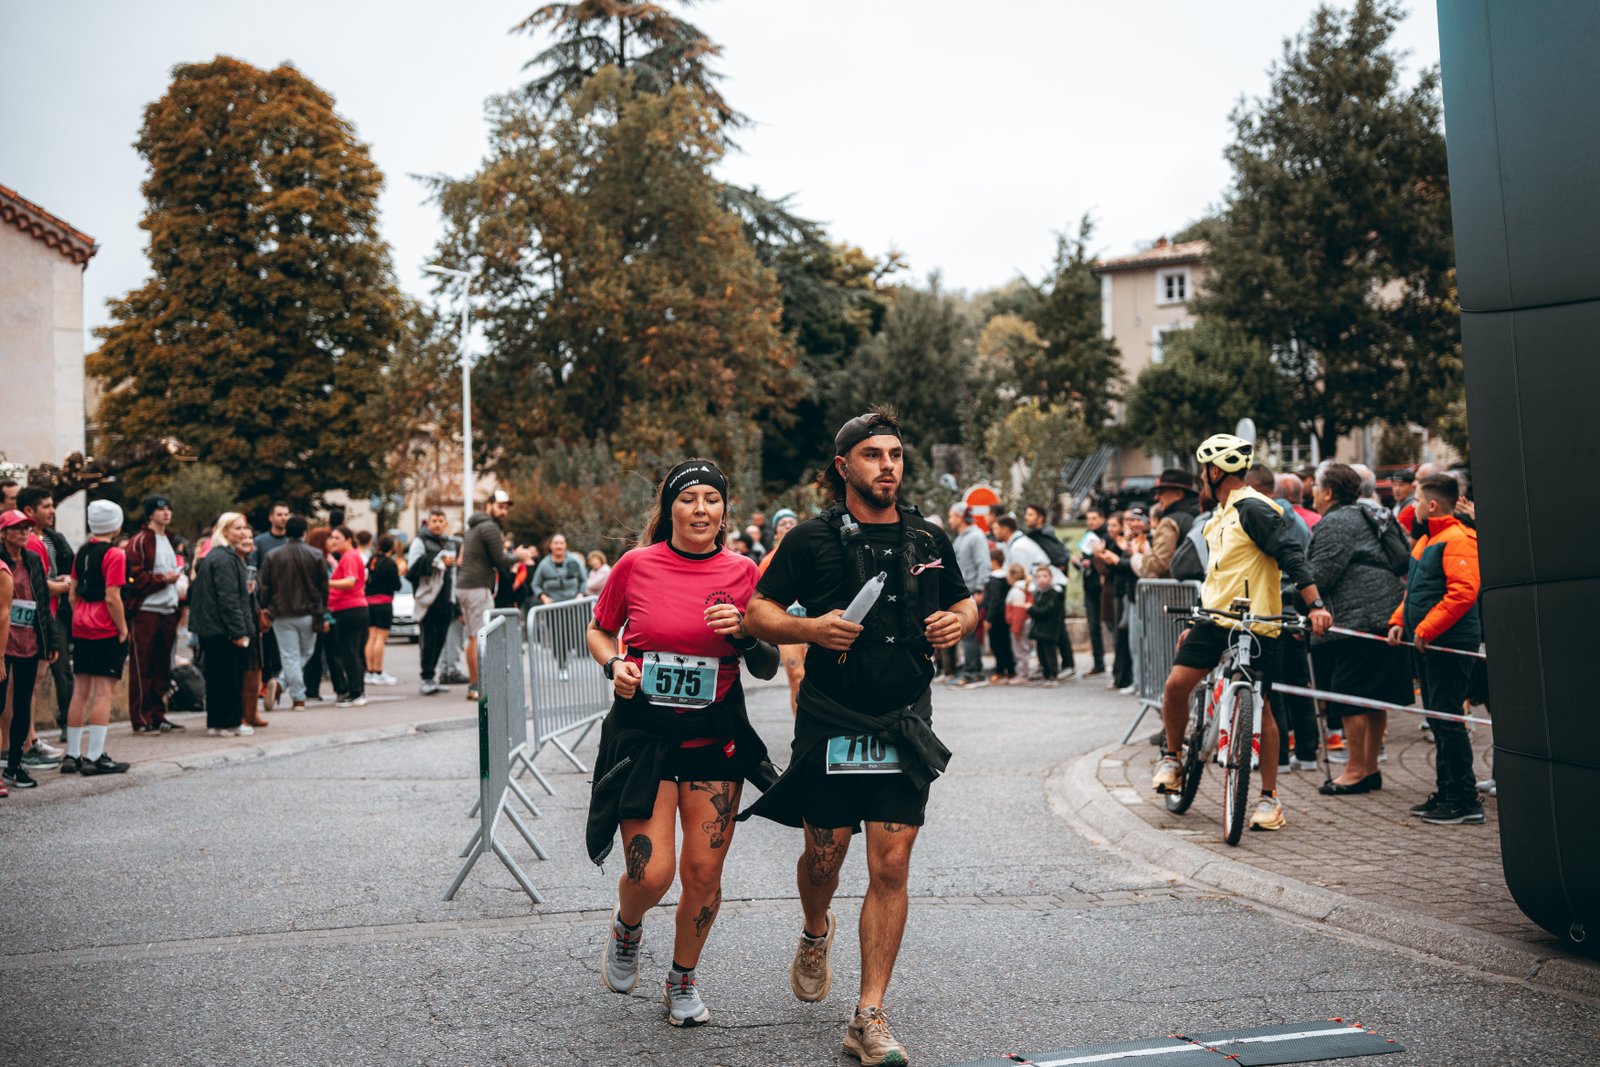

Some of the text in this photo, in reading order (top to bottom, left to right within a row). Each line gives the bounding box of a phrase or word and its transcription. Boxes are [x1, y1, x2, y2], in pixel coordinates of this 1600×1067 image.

[16, 607, 34, 622] 10
[655, 667, 701, 697] 575
[844, 735, 887, 762] 710
